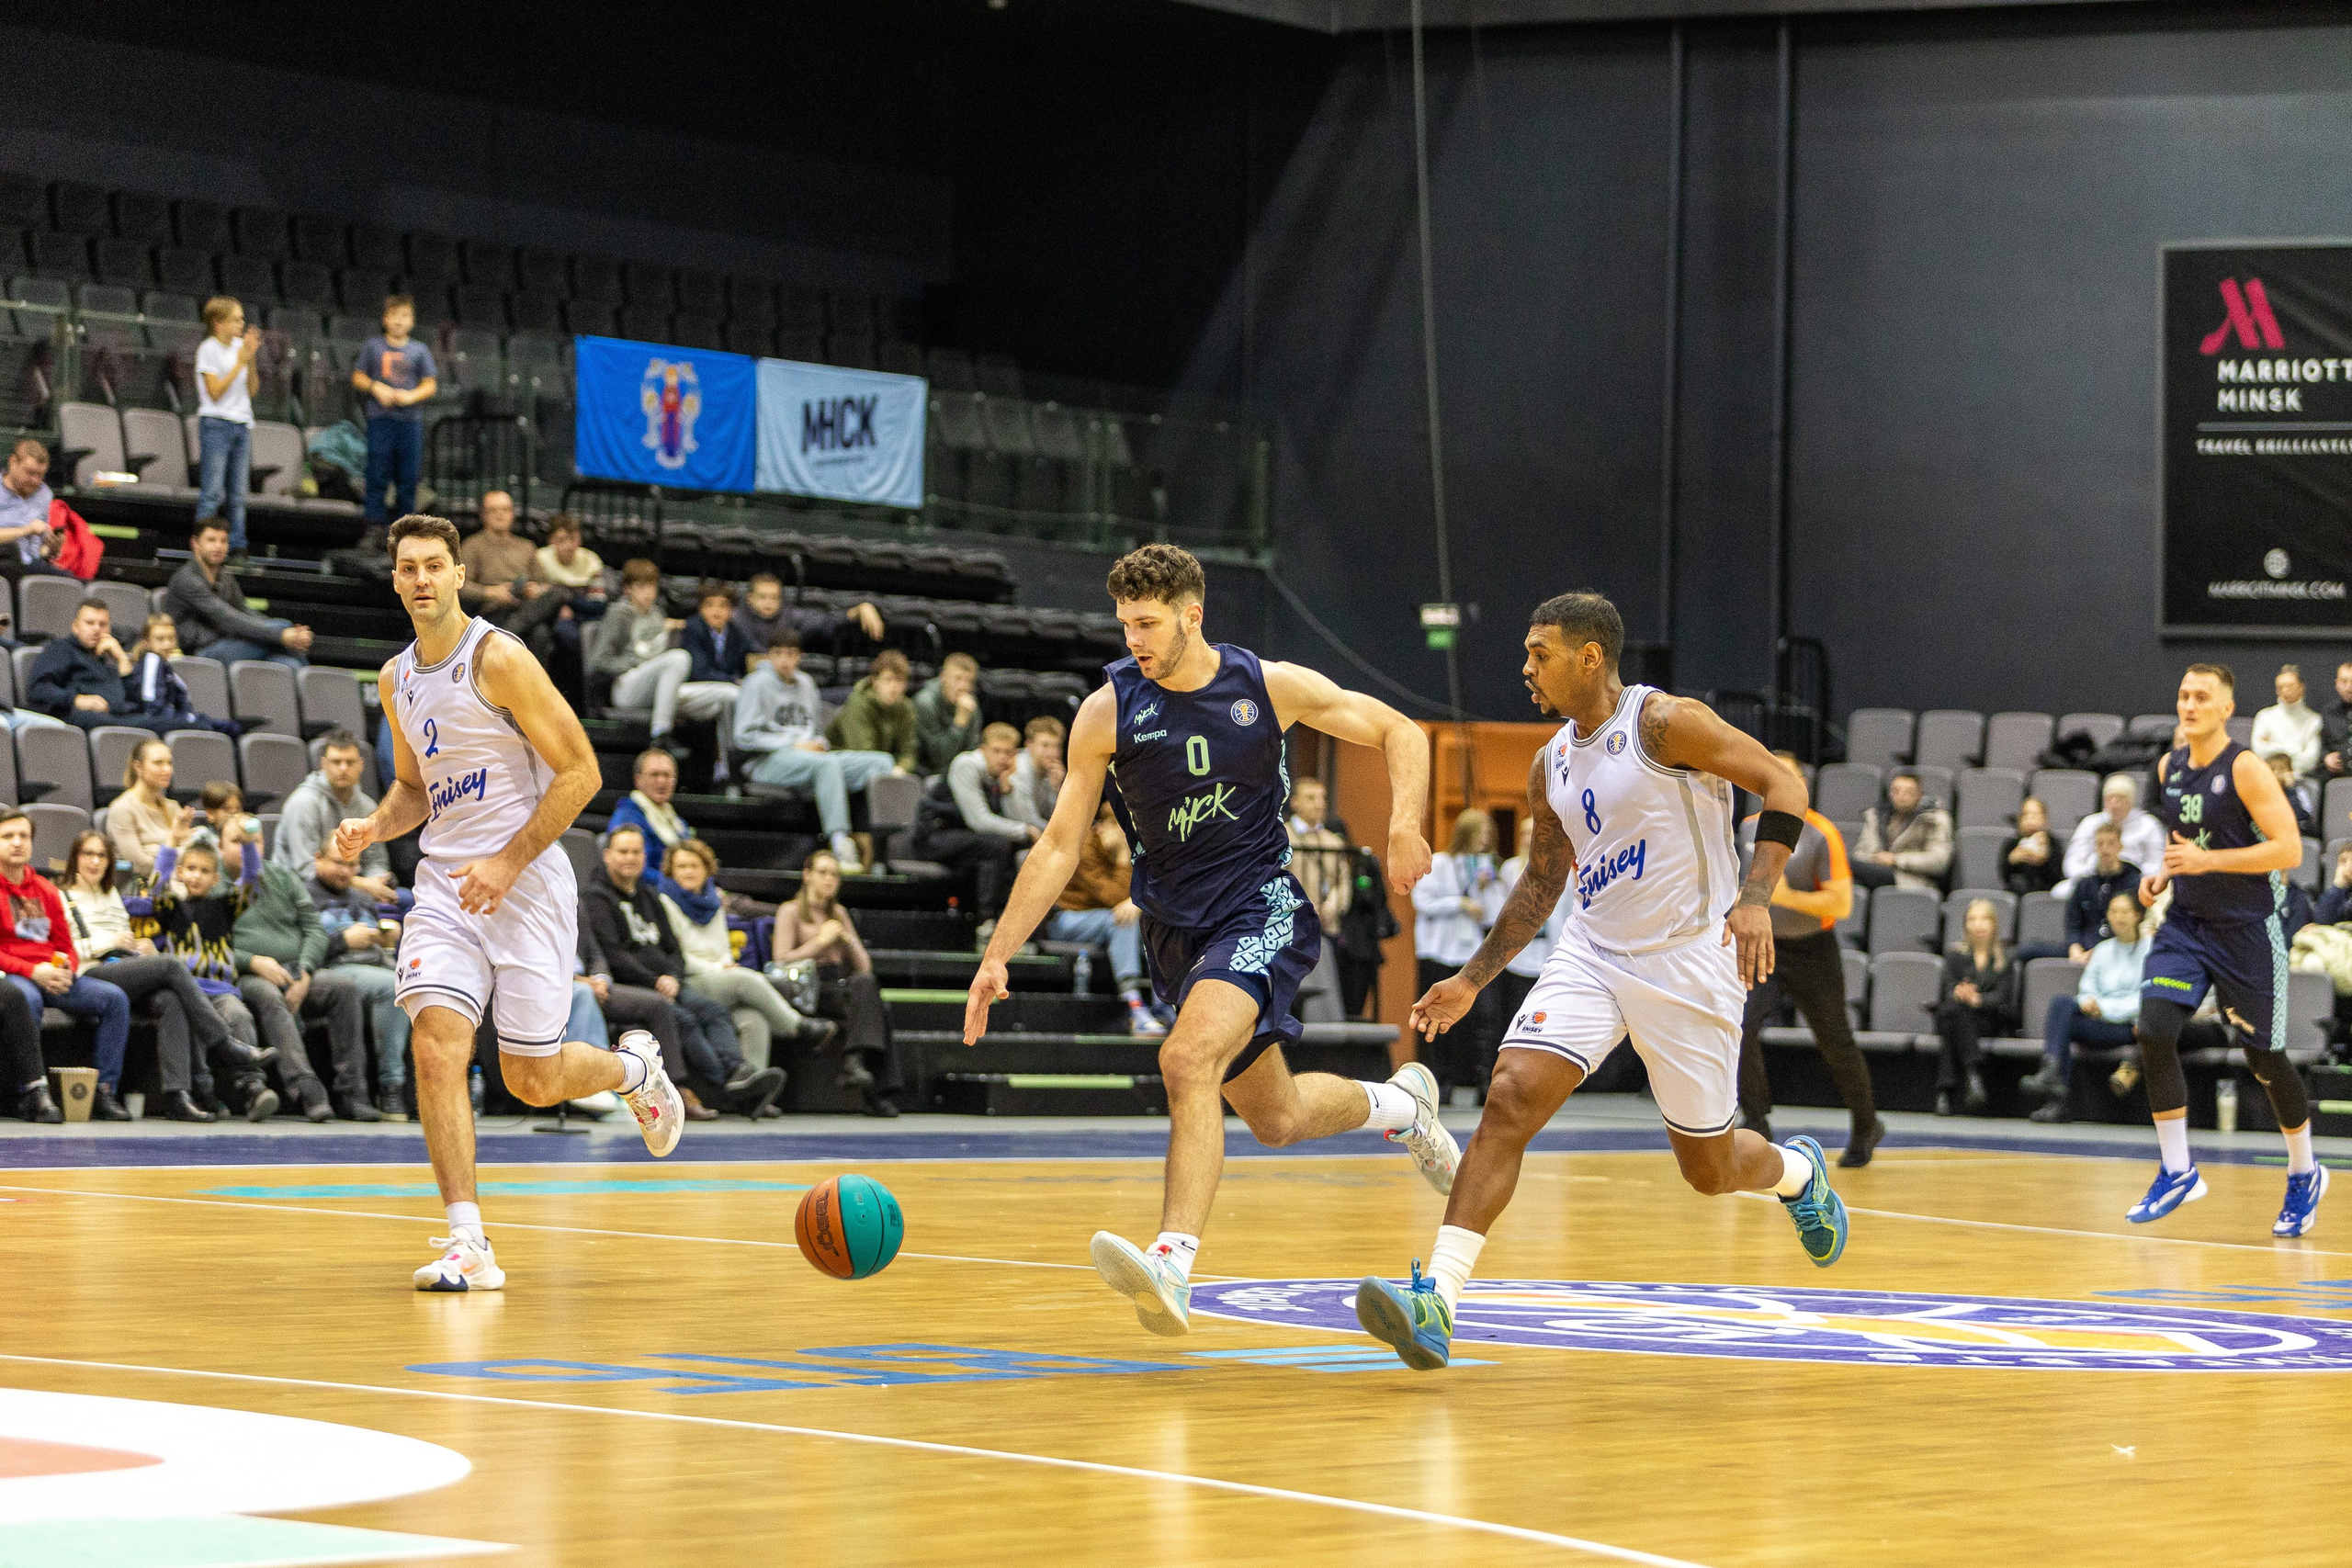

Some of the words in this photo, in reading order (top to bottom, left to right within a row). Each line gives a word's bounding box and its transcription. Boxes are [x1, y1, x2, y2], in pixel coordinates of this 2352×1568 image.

[2217, 357, 2352, 383] MARRIOTT
[2217, 387, 2303, 412] MINSK
[424, 718, 439, 759] 2
[1134, 729, 1167, 744] Kempa
[1186, 736, 1210, 775] 0
[428, 768, 487, 822] Enisey
[1581, 788, 1600, 835] 8
[2178, 793, 2204, 824] 38
[1577, 839, 1646, 910] Enisey
